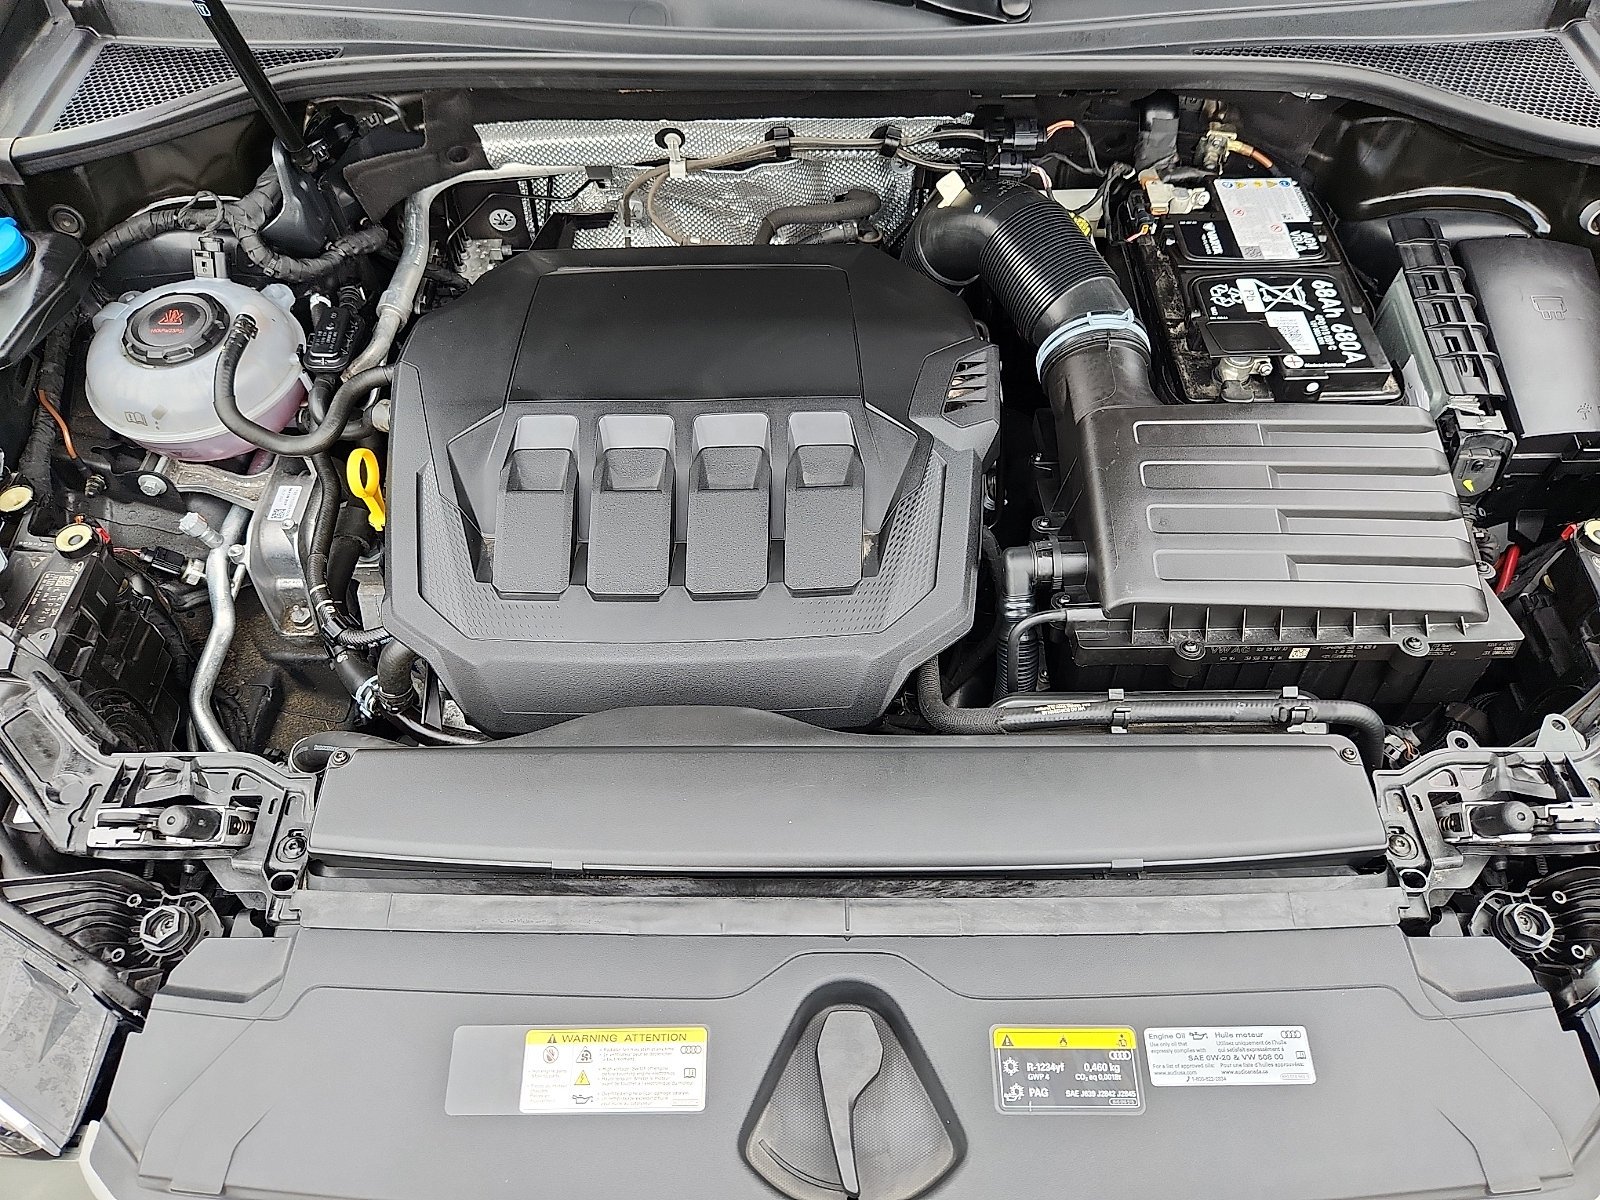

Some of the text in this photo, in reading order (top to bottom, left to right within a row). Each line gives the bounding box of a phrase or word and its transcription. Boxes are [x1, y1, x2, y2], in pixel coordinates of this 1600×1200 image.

[1290, 230, 1307, 252] VRLA
[1300, 232, 1319, 250] AGM
[1244, 289, 1254, 302] Pb
[1312, 280, 1344, 318] 68Ah
[1331, 323, 1366, 364] 680A
[562, 1033, 687, 1043] WARNING ATTENTION
[1026, 1062, 1120, 1073] R-1234yf 0,460 kg
[1028, 1088, 1049, 1098] PAG
